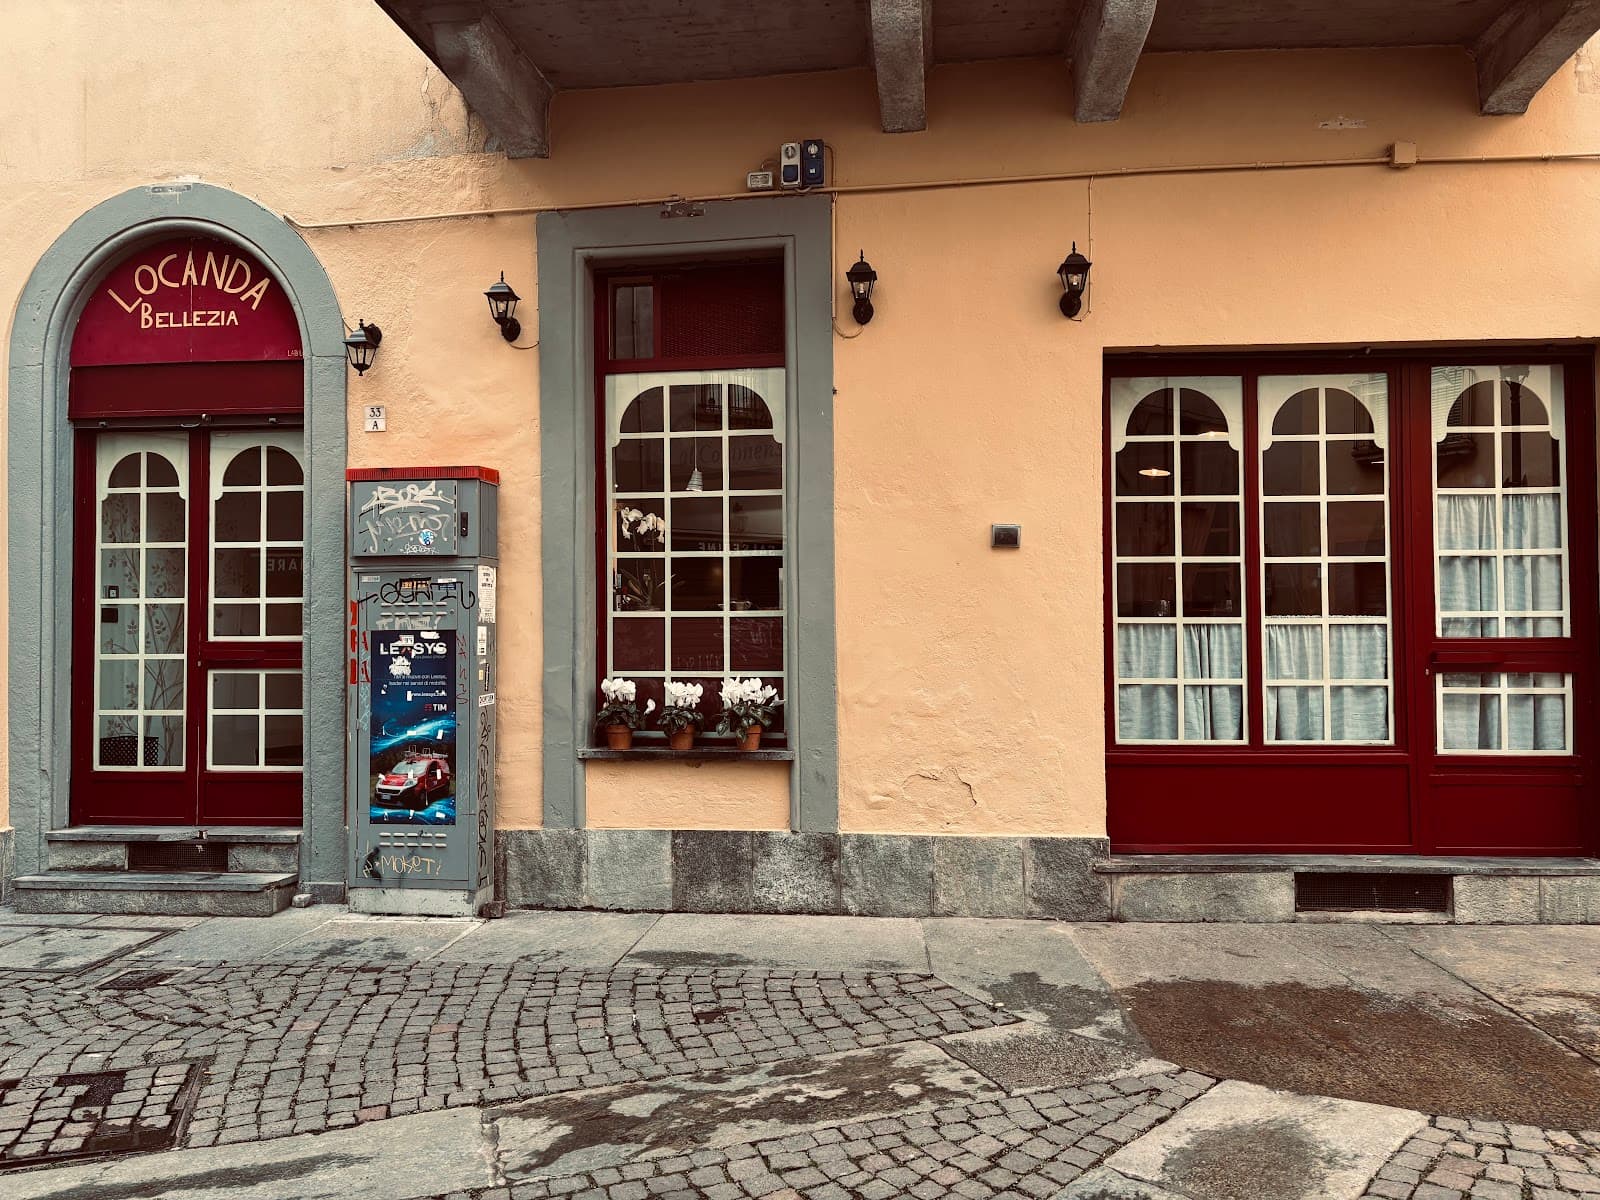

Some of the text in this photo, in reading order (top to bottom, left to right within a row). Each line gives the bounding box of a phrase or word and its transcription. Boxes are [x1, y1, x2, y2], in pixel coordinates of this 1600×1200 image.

[107, 250, 271, 313] LOCANDA
[140, 302, 239, 329] BELLEZIA
[369, 407, 381, 418] 33
[372, 420, 379, 430] A
[379, 642, 447, 655] LEASYS
[432, 703, 447, 712] TIM
